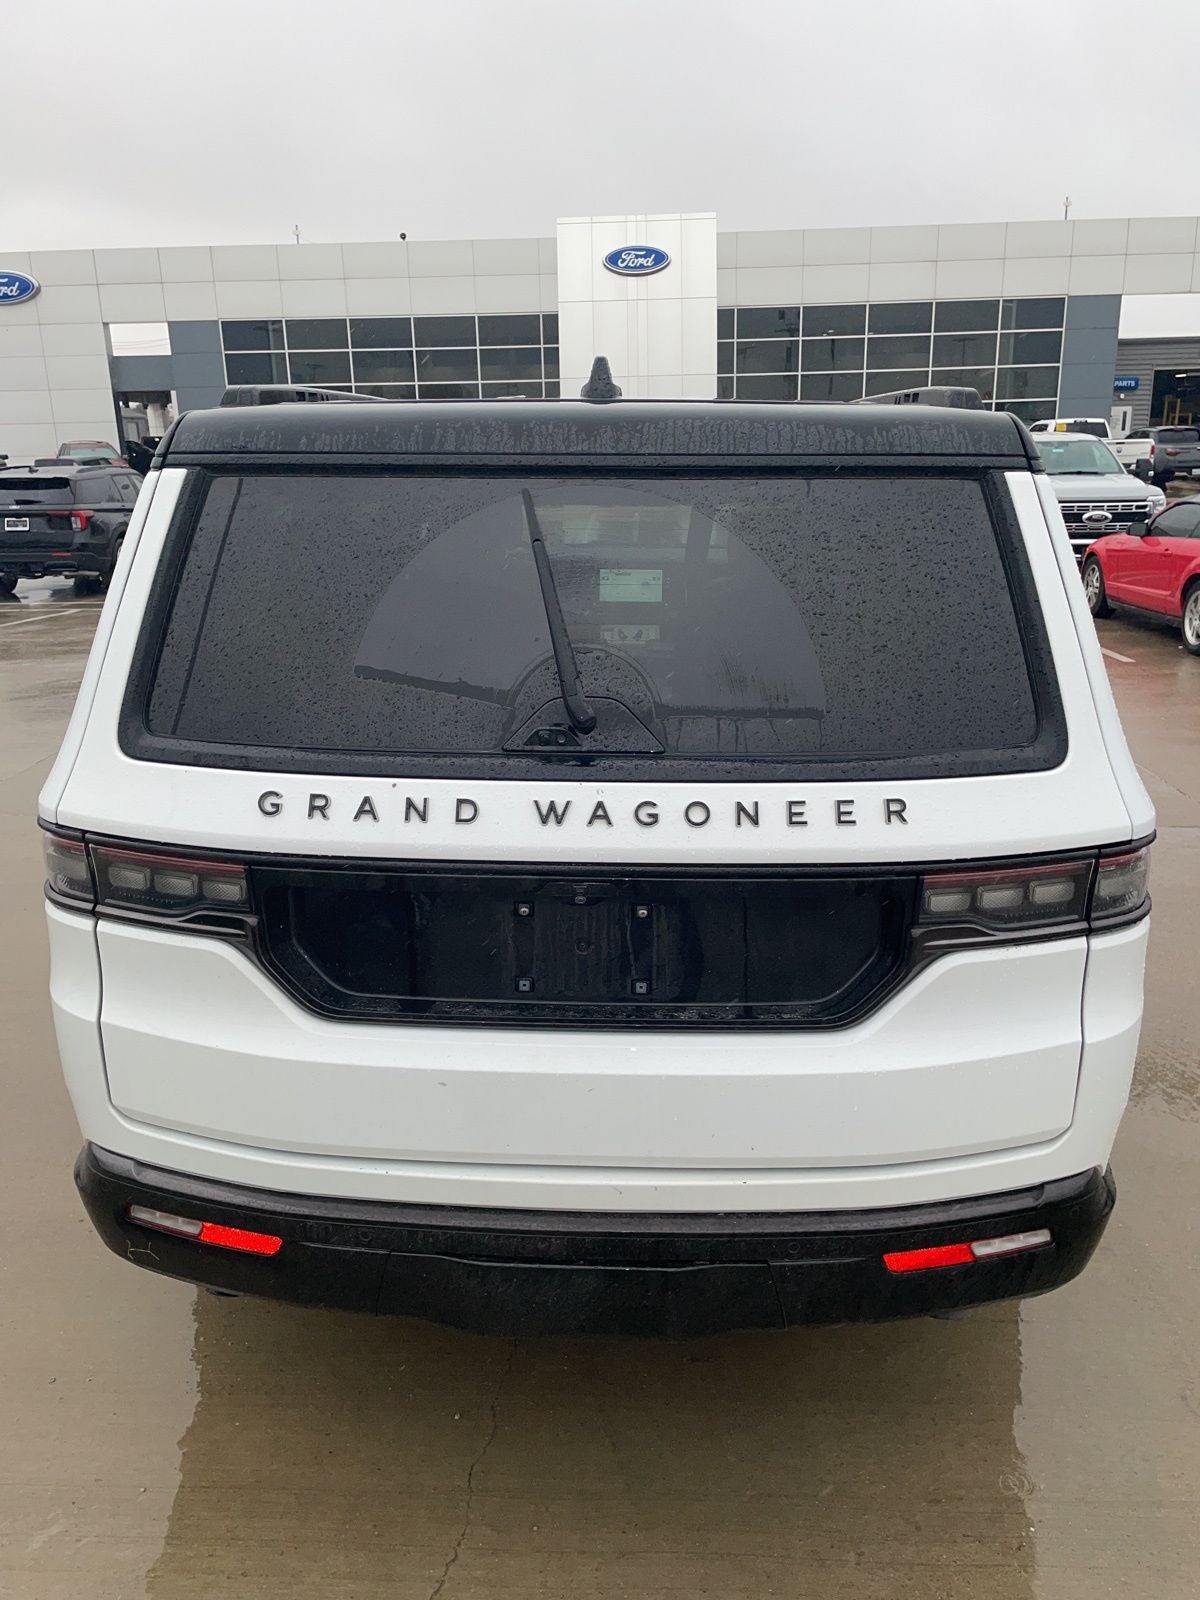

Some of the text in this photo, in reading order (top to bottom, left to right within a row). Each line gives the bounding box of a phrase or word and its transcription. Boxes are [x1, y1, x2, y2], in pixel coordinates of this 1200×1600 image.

[617, 250, 656, 267] Ford
[257, 790, 908, 828] GRAND WAGONEER
